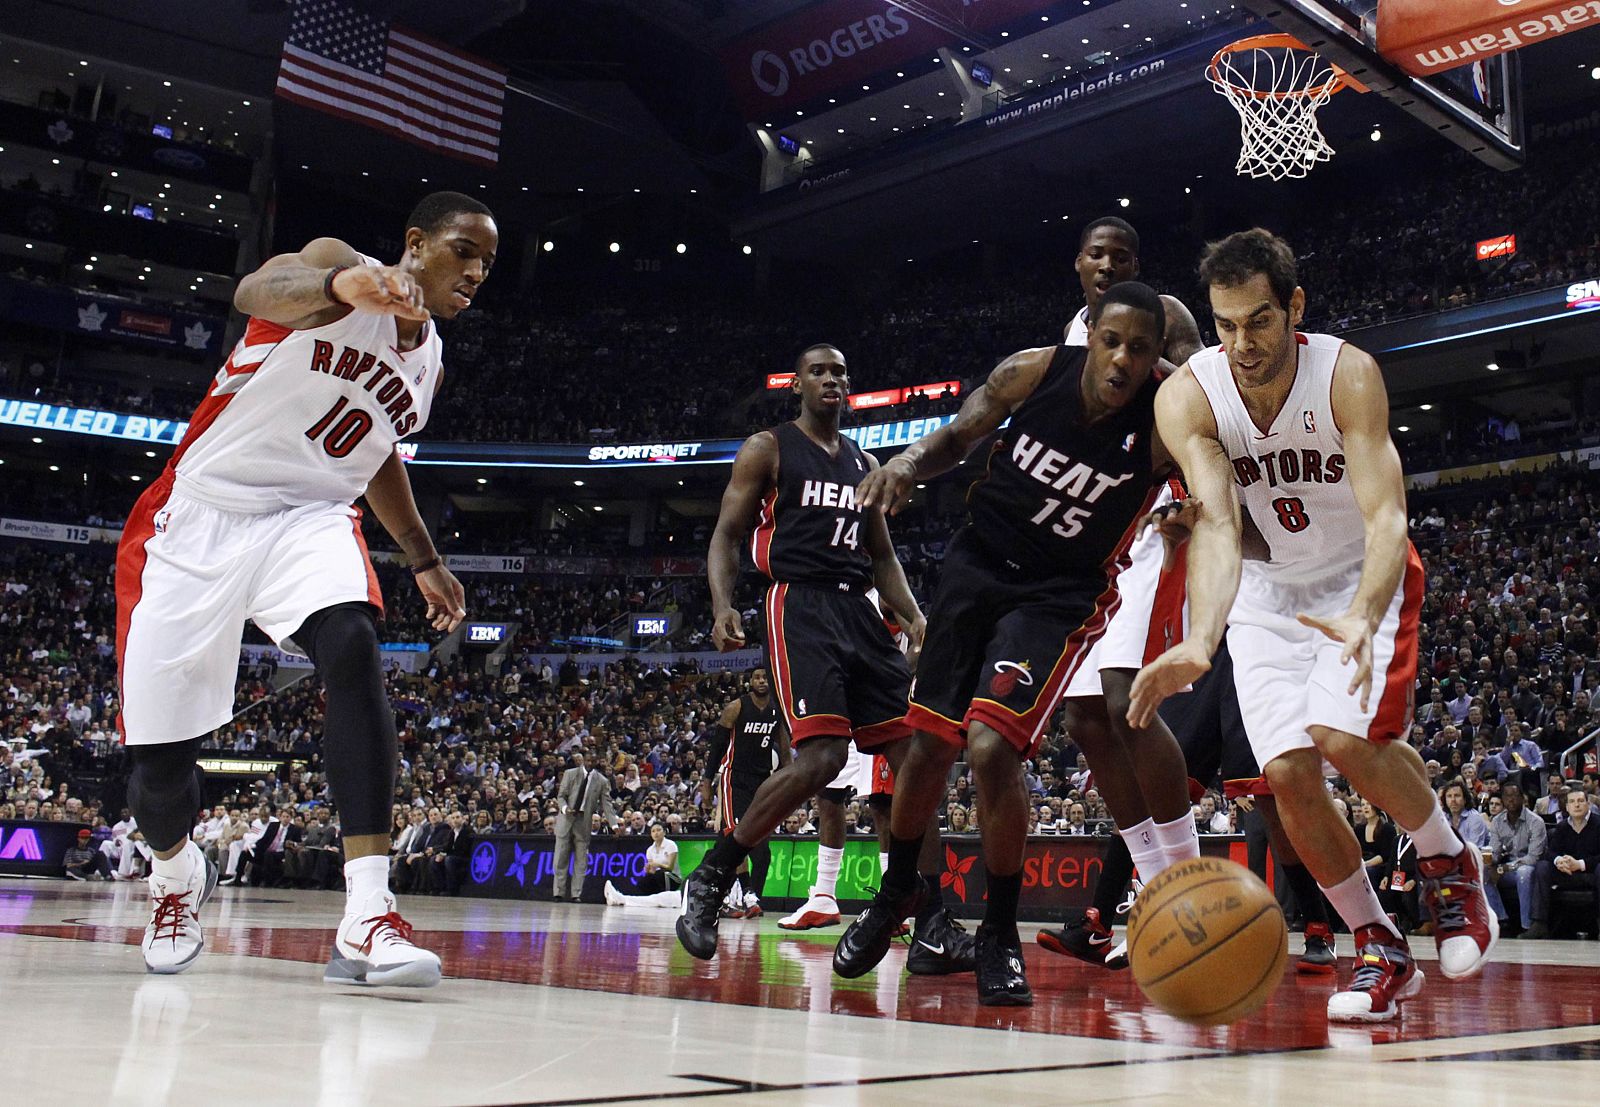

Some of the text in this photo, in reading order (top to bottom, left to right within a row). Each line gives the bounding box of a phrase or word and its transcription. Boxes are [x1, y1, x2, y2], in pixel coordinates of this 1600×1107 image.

[789, 6, 909, 75] ROGERS
[1415, 0, 1600, 67] tateFarm
[985, 59, 1165, 126] www.mapleleafs.com
[310, 339, 418, 437] RAPTORS
[0, 399, 118, 434] UELLED
[121, 416, 171, 441] BY
[304, 395, 373, 458] 10
[588, 443, 702, 461] SPORTSNET
[1012, 433, 1134, 504] HEAT
[1030, 498, 1093, 538] 15
[1272, 497, 1310, 533] 8
[66, 528, 89, 541] 115
[831, 517, 859, 551] 14
[502, 559, 522, 570] 116
[471, 626, 501, 642] IBM
[637, 620, 665, 634] IBM
[707, 656, 750, 668] smarter
[744, 721, 777, 734] HEAT
[760, 735, 770, 748] 6
[252, 763, 277, 772] DRAFT
